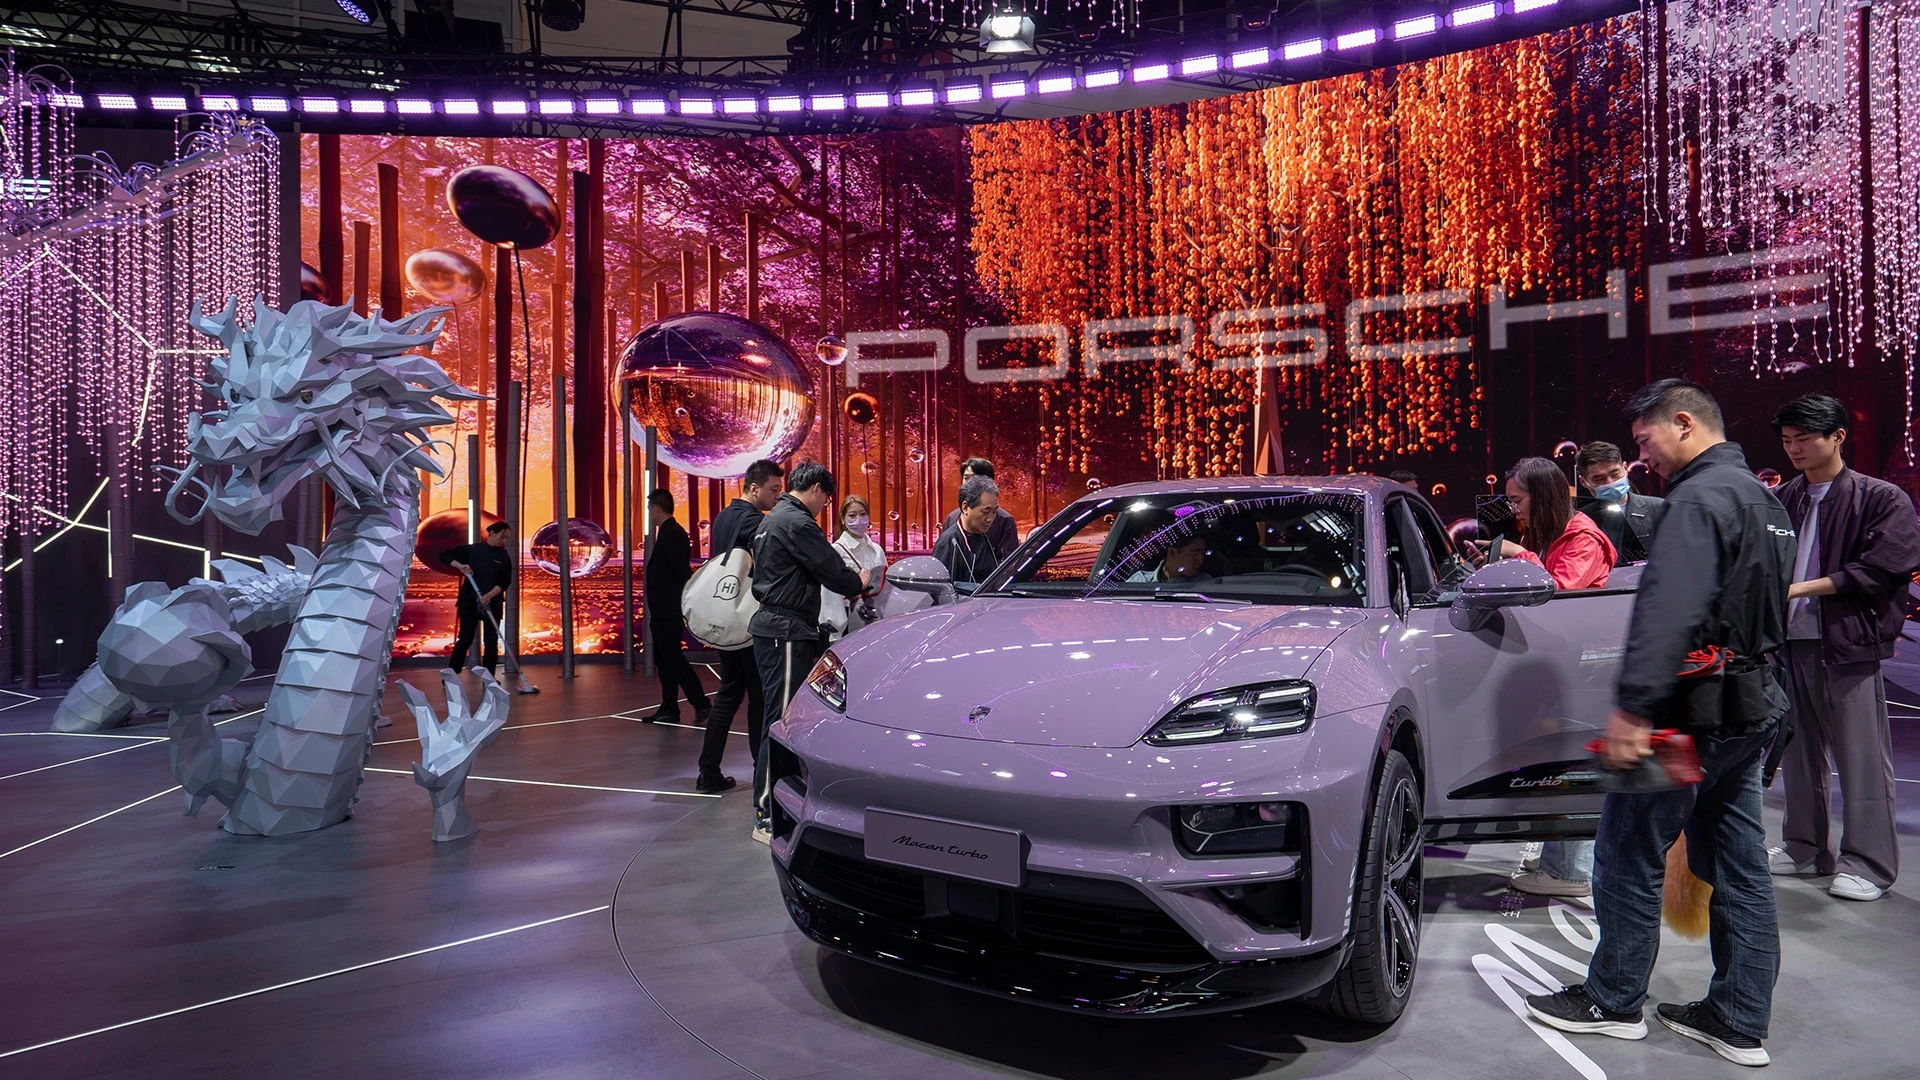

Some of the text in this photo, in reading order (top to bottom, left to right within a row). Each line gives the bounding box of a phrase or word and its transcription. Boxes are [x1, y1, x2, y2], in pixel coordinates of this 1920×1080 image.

[845, 241, 1829, 388] PORSCHE
[721, 582, 736, 594] Hi
[1509, 777, 1562, 788] turbo
[892, 835, 989, 860] Macan turbo
